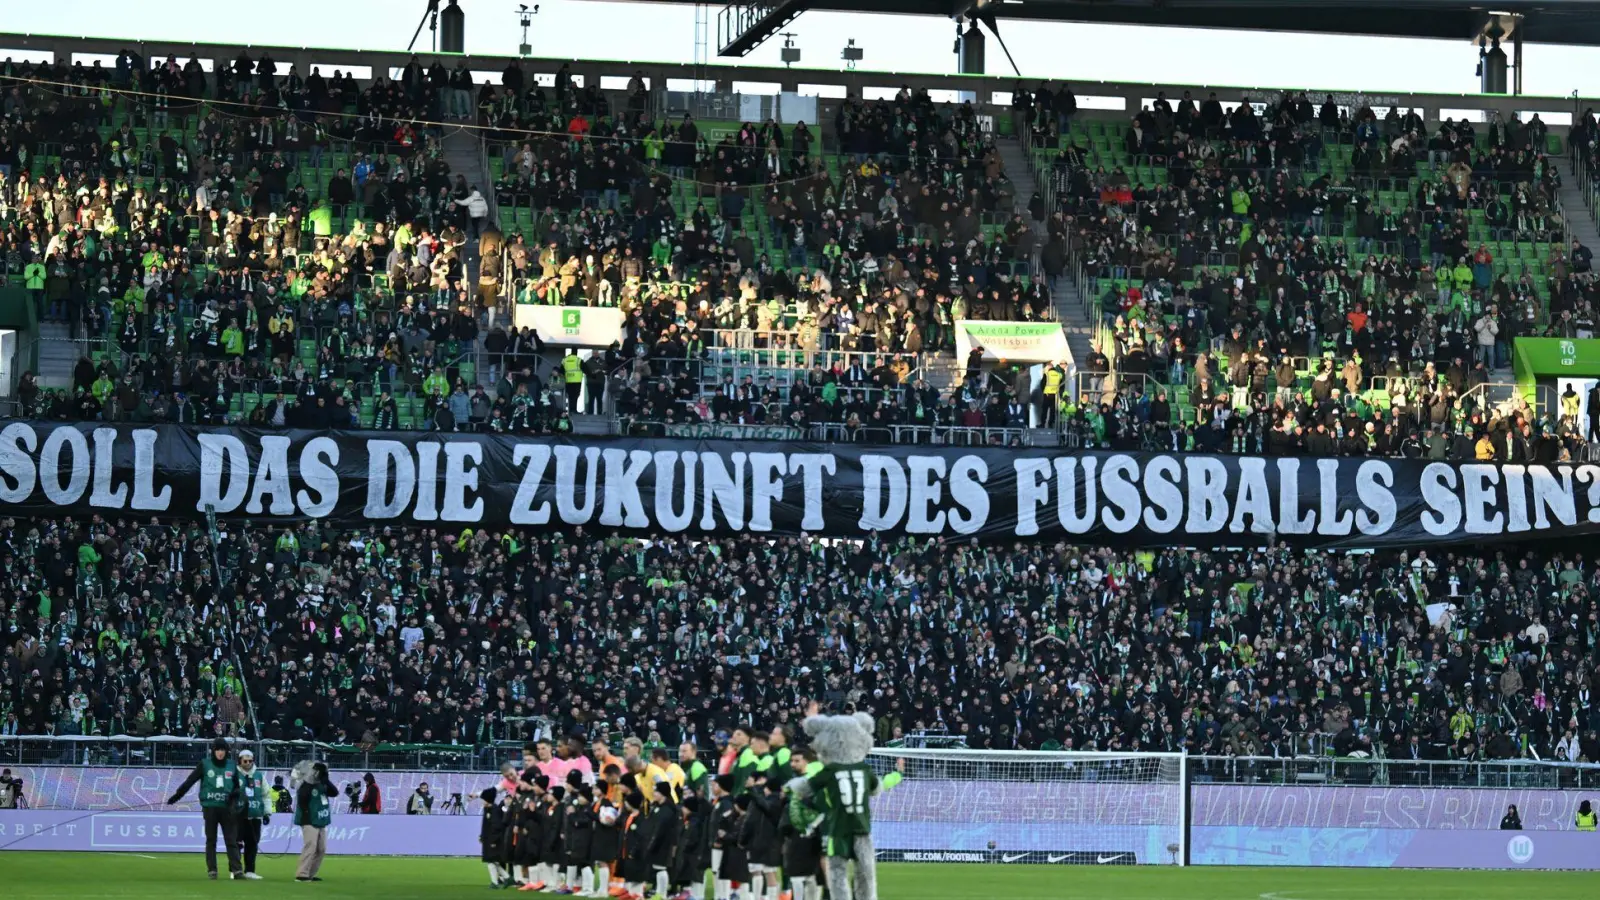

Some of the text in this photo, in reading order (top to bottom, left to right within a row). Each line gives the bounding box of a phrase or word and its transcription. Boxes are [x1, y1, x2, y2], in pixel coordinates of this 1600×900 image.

[568, 314, 576, 324] 6
[977, 326, 1047, 335] Arena Power
[1561, 345, 1575, 354] 10
[0, 422, 1600, 536] SOLL DAS DIE ZUKUNFT DES FUSSBALLS SEIN?
[903, 851, 985, 862] NIKE.COM/FOOTBALL
